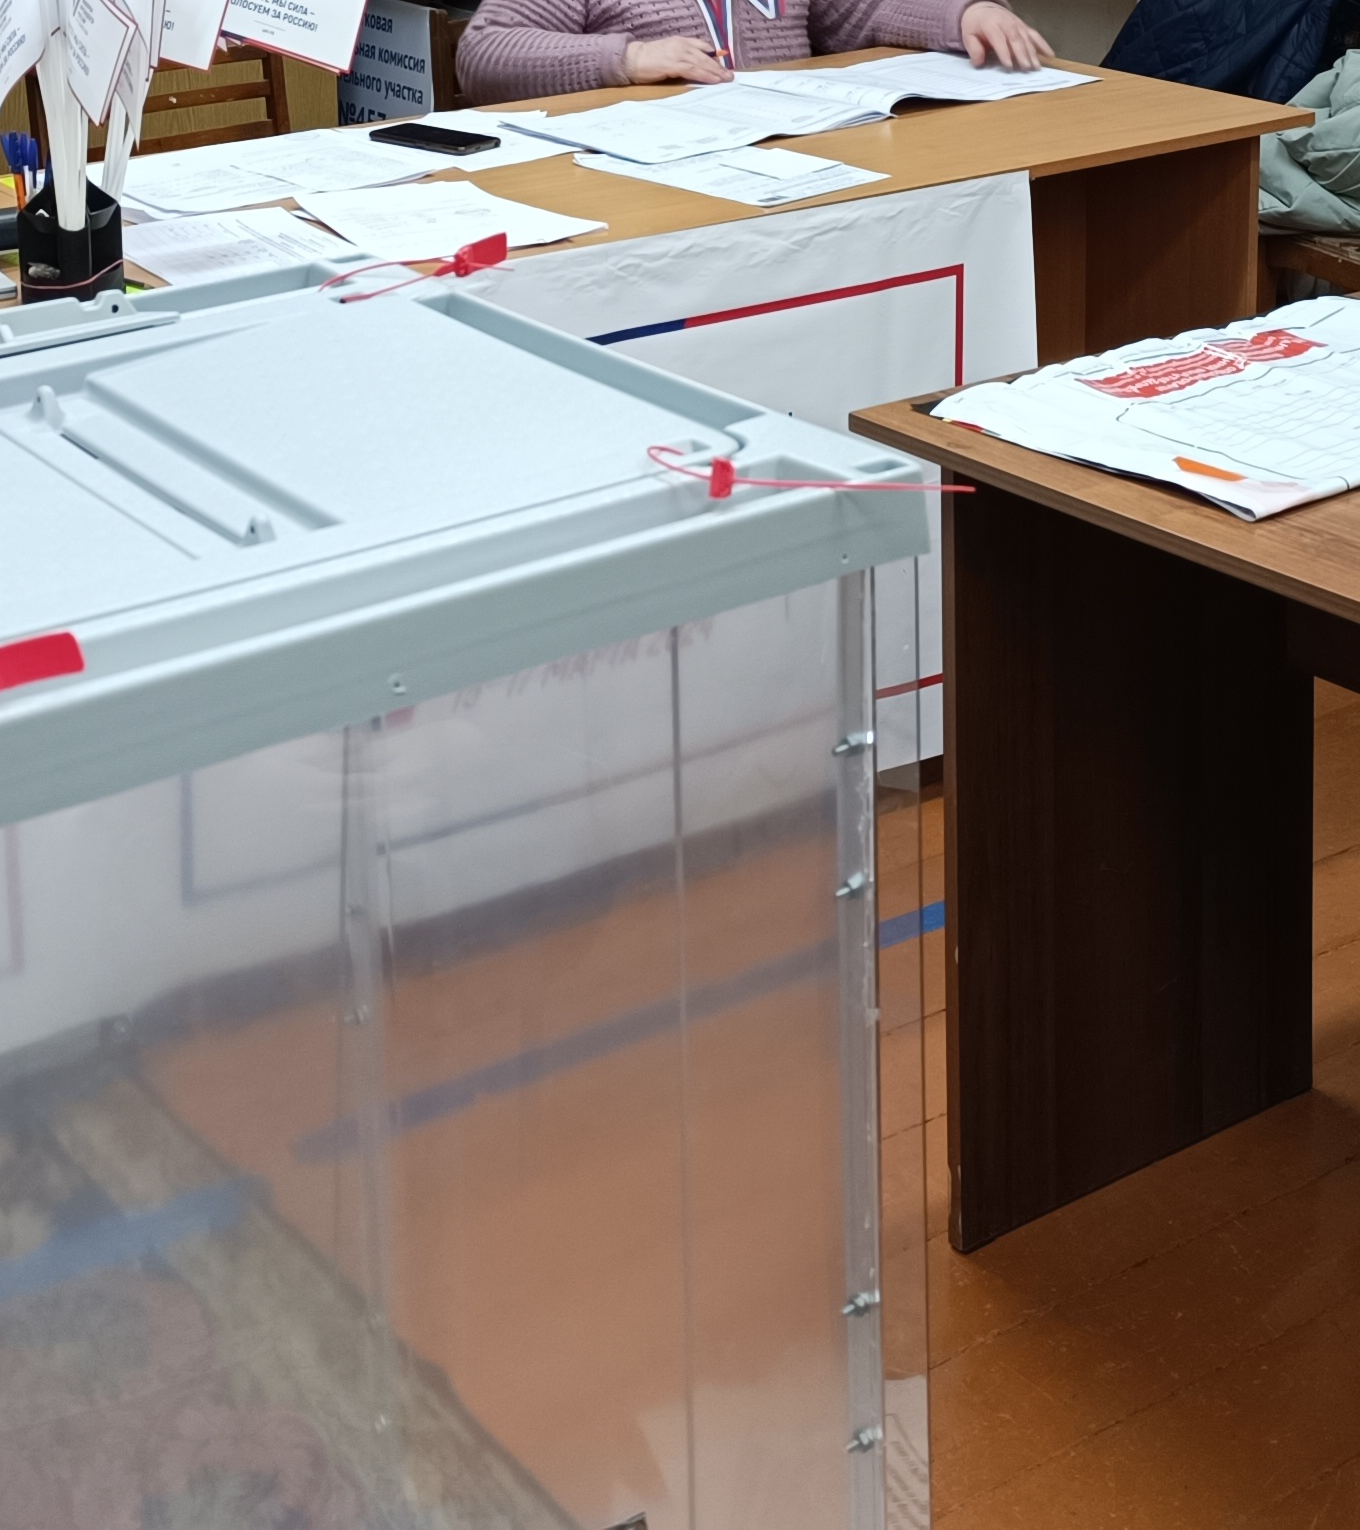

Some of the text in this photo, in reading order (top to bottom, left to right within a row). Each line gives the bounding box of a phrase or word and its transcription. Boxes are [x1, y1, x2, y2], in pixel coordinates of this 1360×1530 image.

[271, 9, 281, 20] ЗА
[282, 13, 319, 32] РОССИЮ!
[287, 2, 308, 15] СИЛА
[378, 47, 426, 74] комиссия
[384, 80, 424, 105] участка
